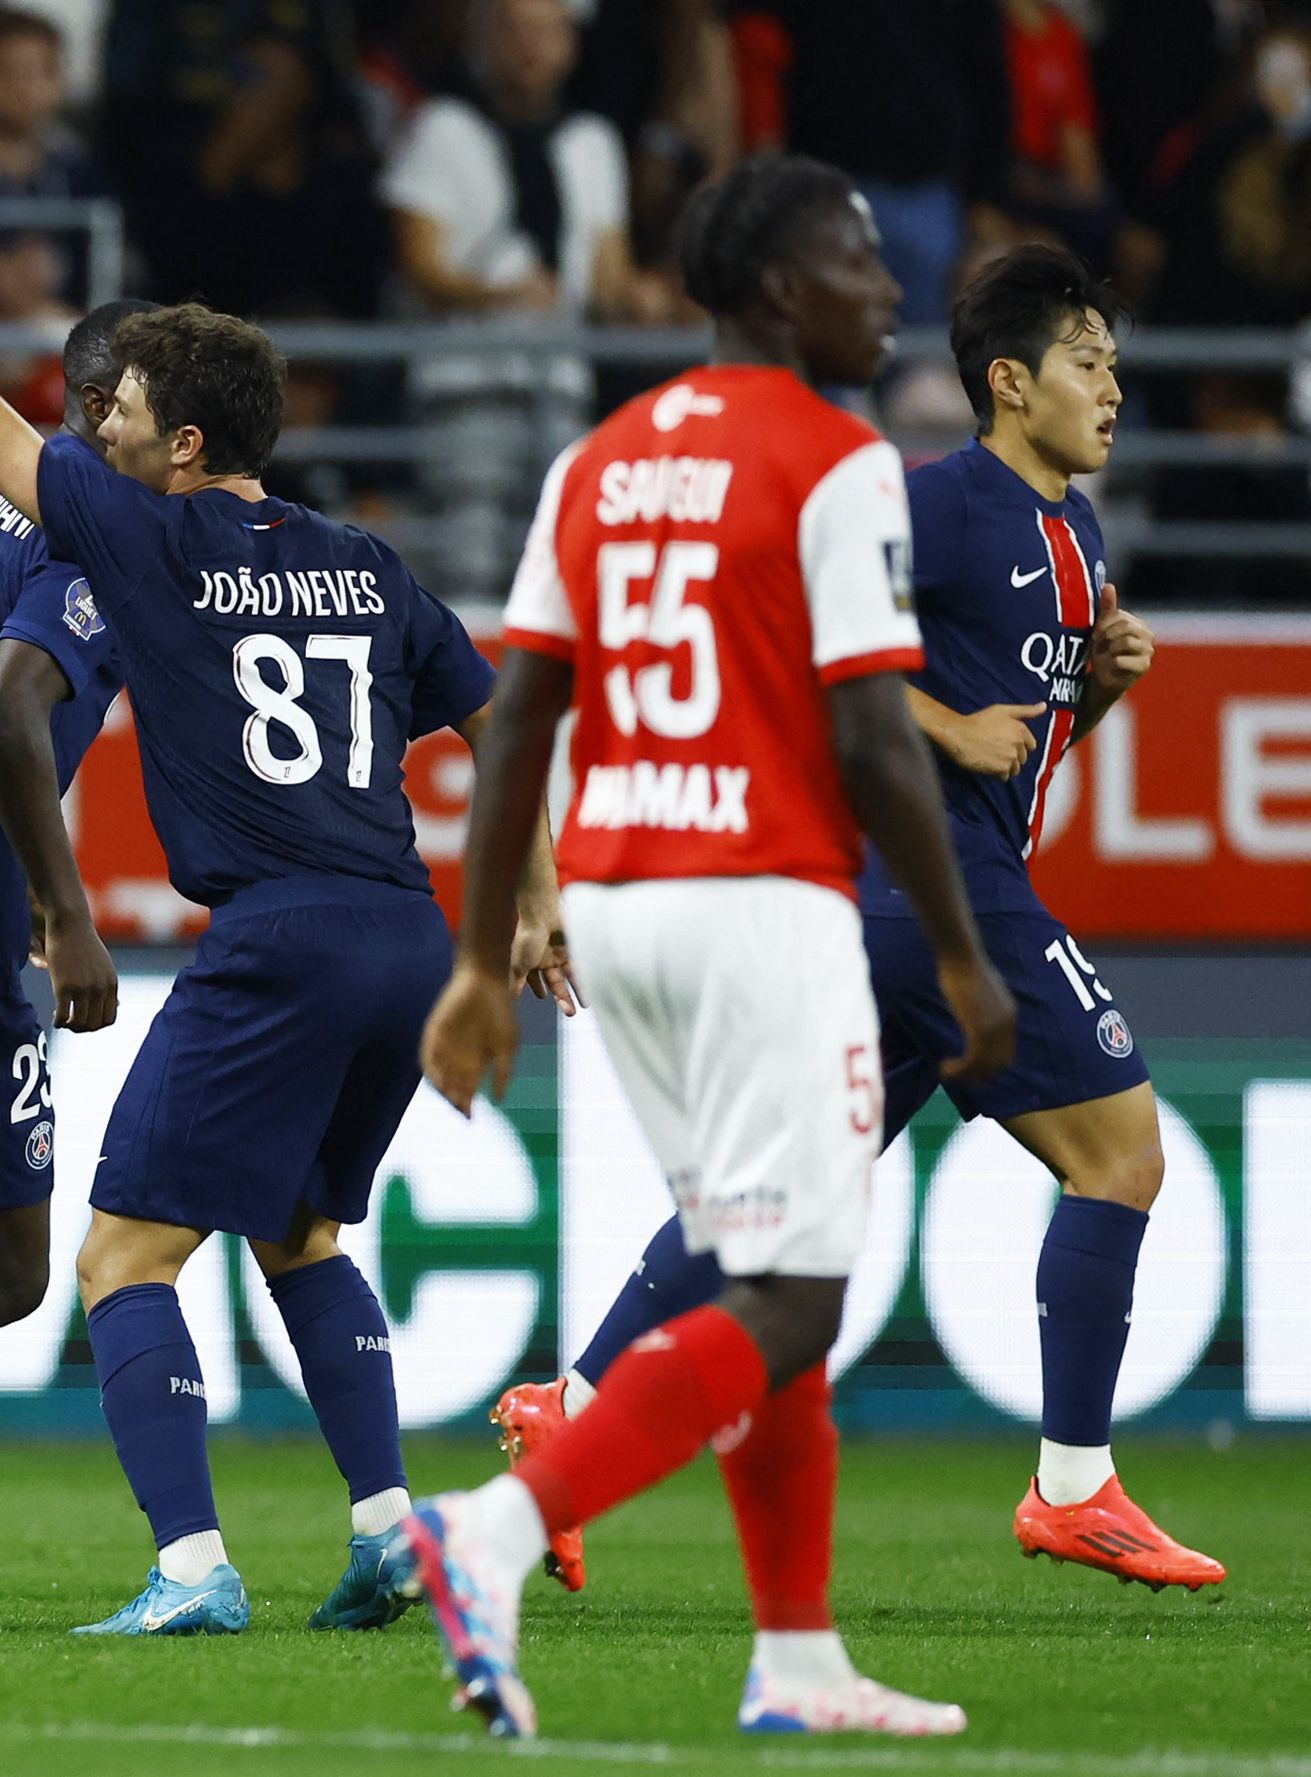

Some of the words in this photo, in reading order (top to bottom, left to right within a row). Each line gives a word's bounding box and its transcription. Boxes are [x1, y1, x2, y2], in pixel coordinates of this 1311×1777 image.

[193, 566, 284, 616] JOÃO
[285, 569, 385, 617] NEVES
[596, 538, 722, 740] 55
[232, 633, 374, 789] 87
